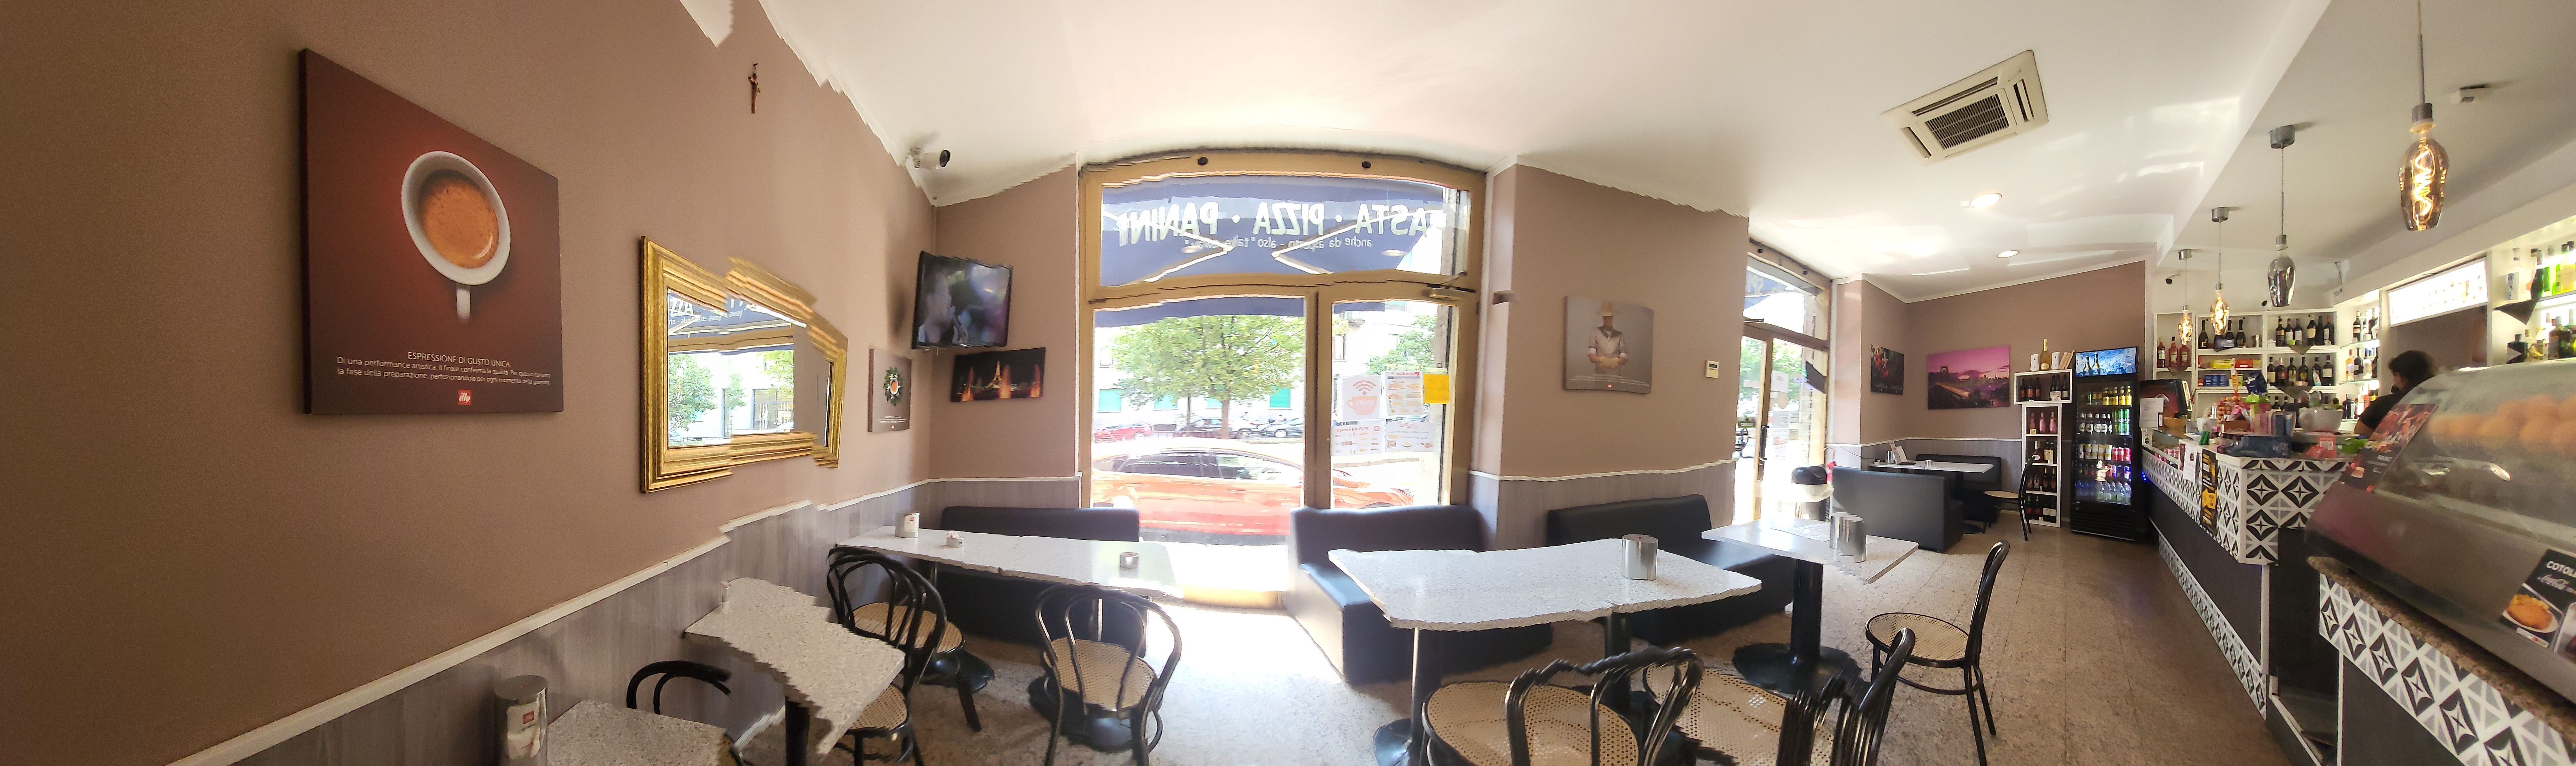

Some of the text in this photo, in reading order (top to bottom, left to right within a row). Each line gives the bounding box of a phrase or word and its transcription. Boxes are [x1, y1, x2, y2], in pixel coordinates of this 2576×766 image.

[364, 359, 410, 368] performance
[408, 352, 457, 363] ESPRESSIONE
[467, 357, 489, 366] GUSTO
[430, 373, 476, 382] perfezionandola
[459, 392, 471, 404] illy
